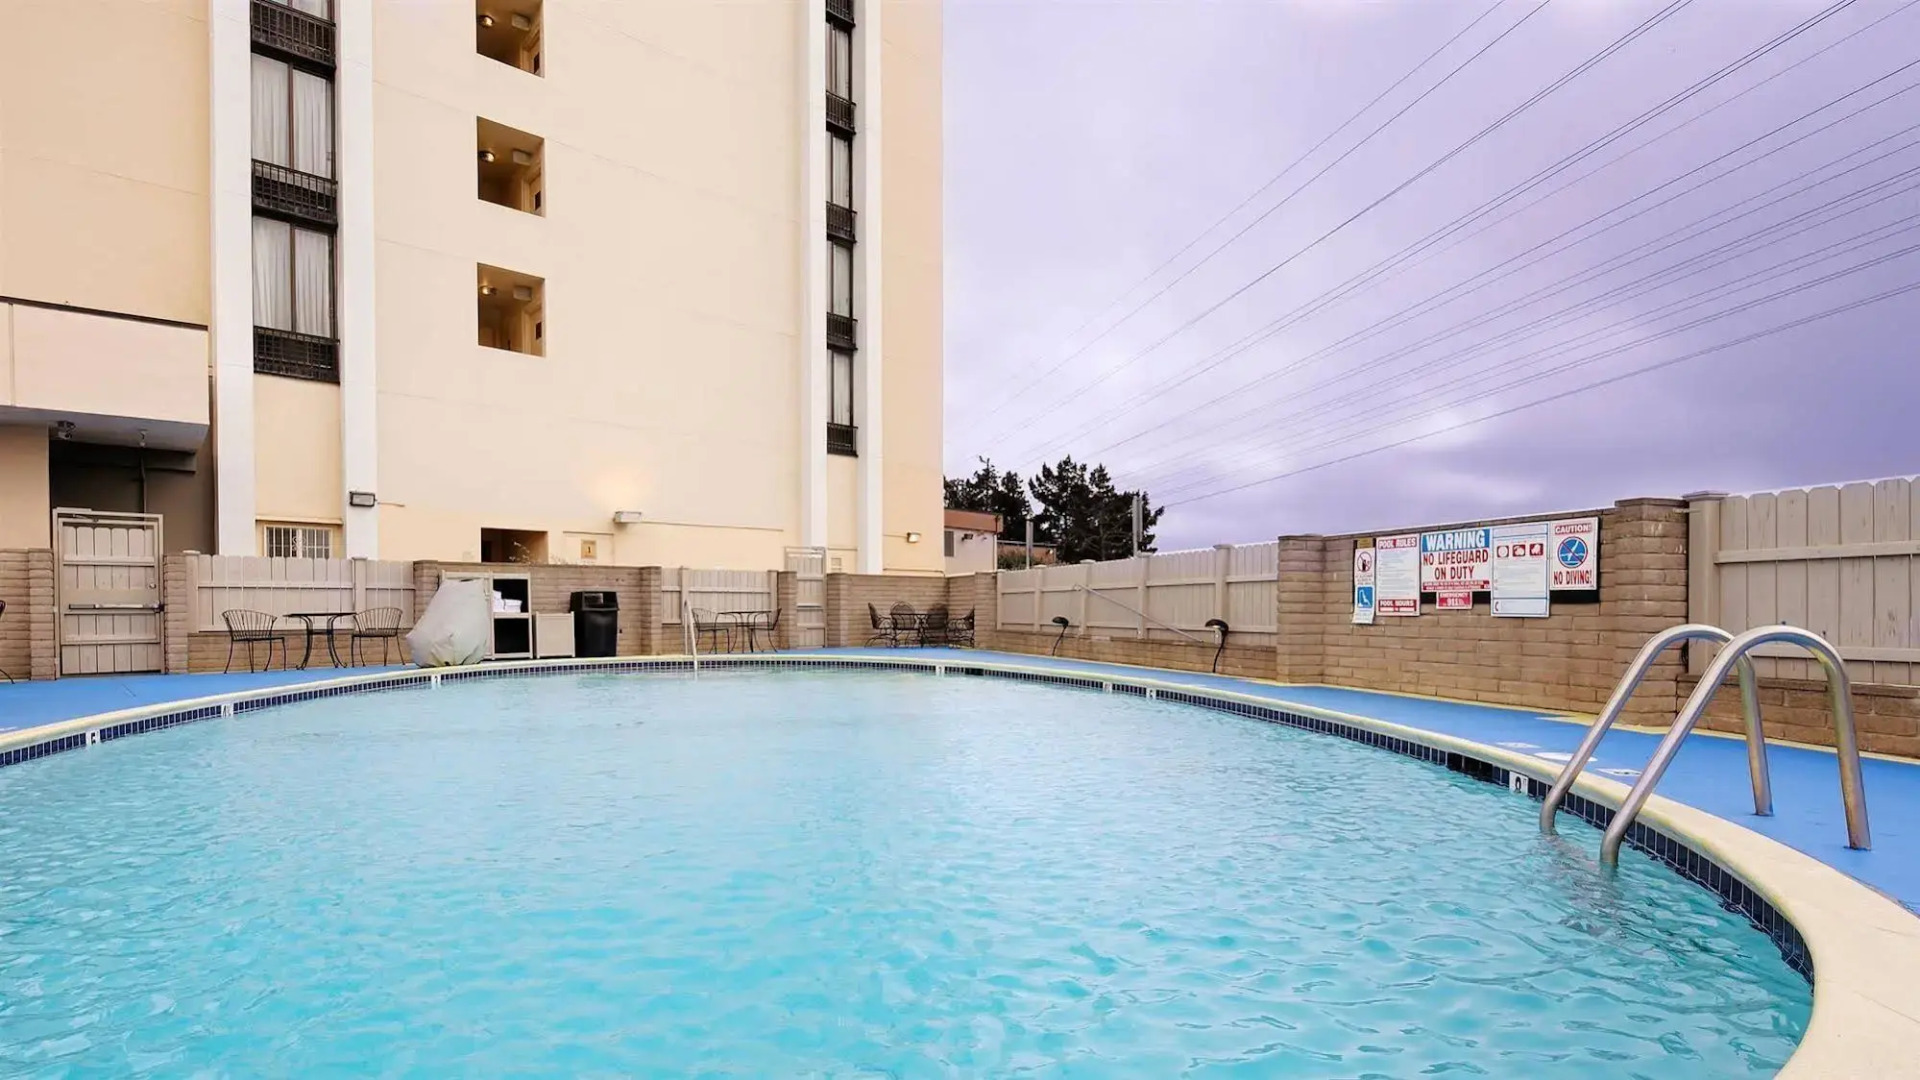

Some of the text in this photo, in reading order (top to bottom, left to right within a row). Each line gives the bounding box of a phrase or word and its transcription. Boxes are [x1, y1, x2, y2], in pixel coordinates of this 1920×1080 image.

[1378, 538, 1416, 548] POOL RULES
[1426, 530, 1485, 551] WARNING
[1423, 550, 1488, 565] NO LIFEGUARD
[1434, 566, 1474, 580] ON DUTY
[1553, 570, 1592, 585] NO DIVING!
